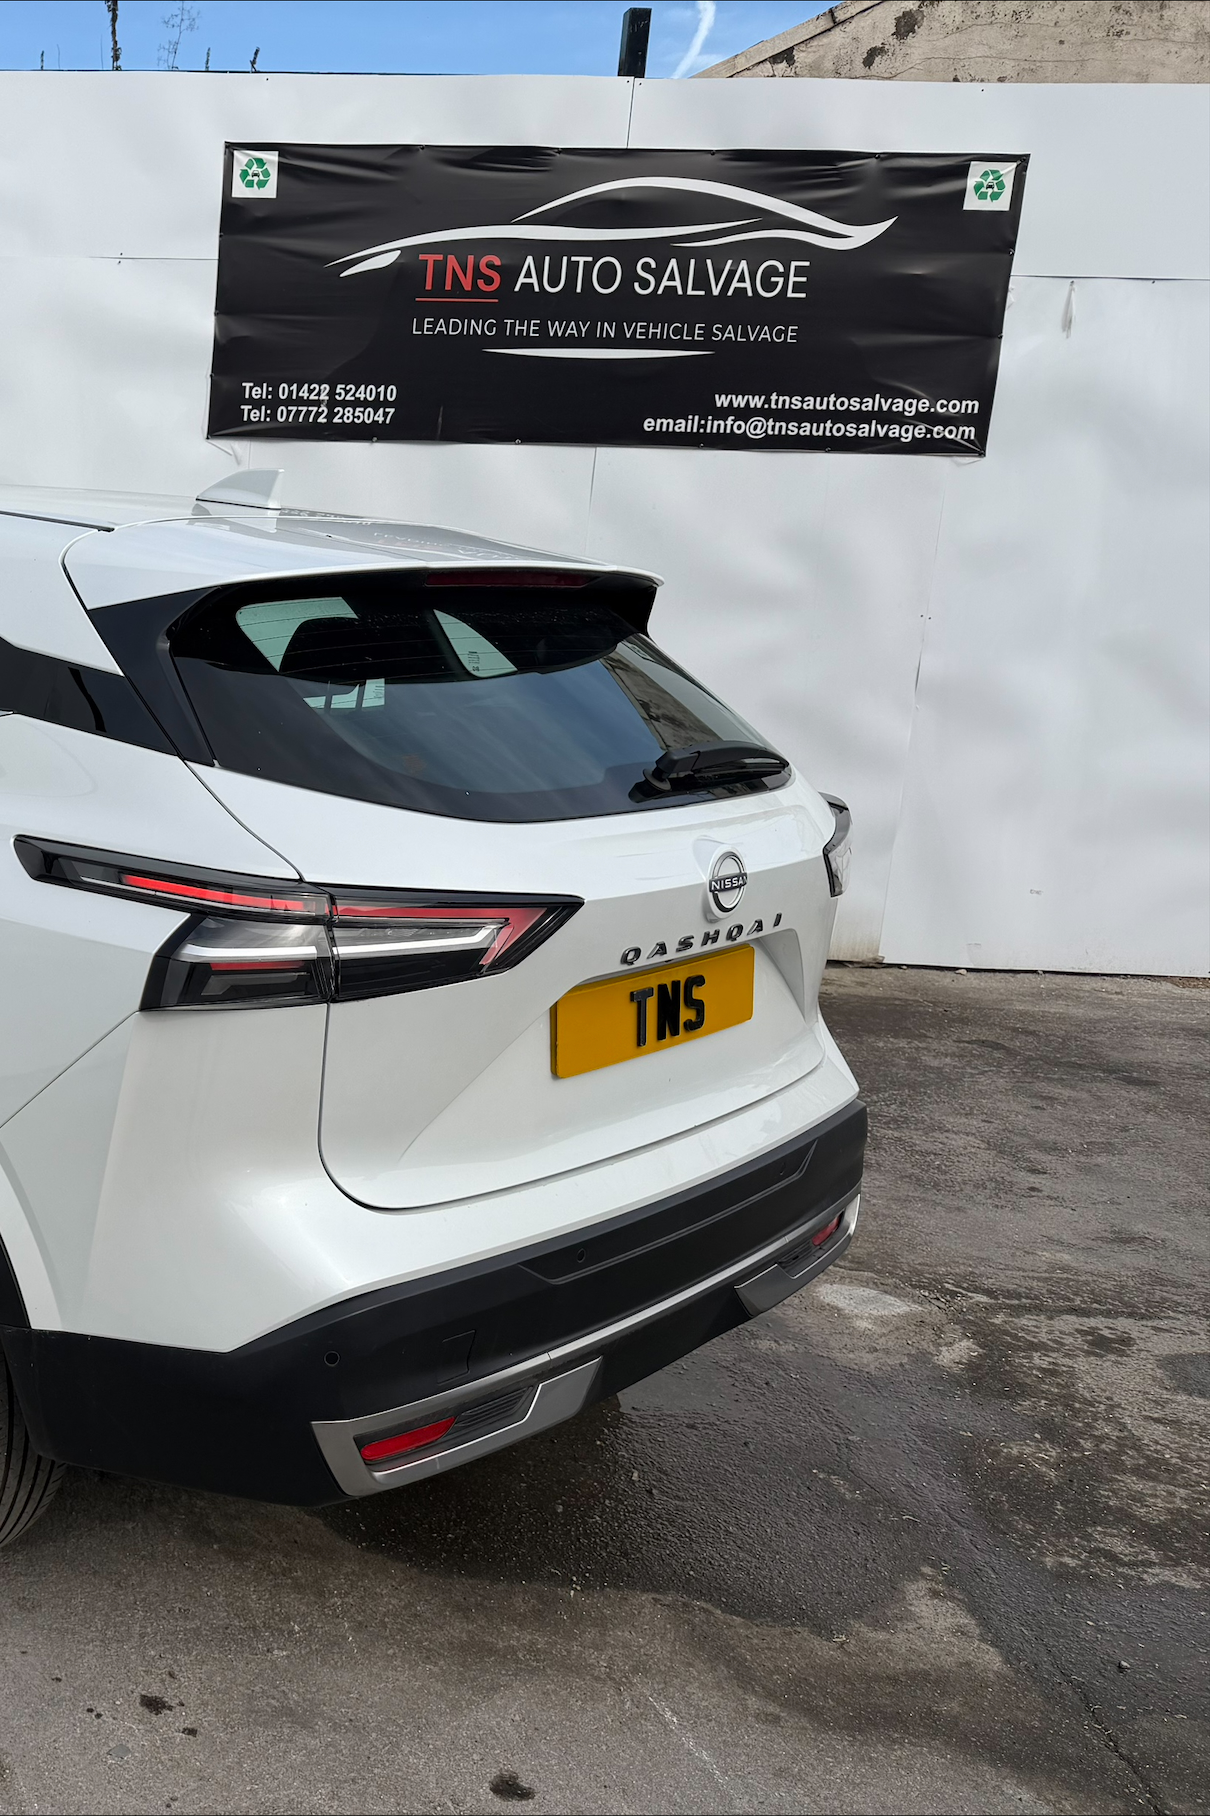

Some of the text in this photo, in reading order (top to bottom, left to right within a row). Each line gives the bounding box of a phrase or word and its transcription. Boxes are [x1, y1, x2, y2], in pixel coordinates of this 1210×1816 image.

[419, 254, 810, 298] TNS AUTO SALVAGE
[413, 318, 798, 342] LEADING THE WAY IN VEHICLE SALVAGE
[242, 383, 396, 401] Tel: 01422 524010
[715, 390, 980, 416] www.tnsautosalvage.com
[240, 405, 395, 424] Tel: 07772 285047
[642, 414, 976, 443] email:info@tnsautosalvage.com
[711, 875, 747, 891] NISSAN
[620, 913, 783, 966] QASHQAI
[629, 974, 706, 1048] TNS
